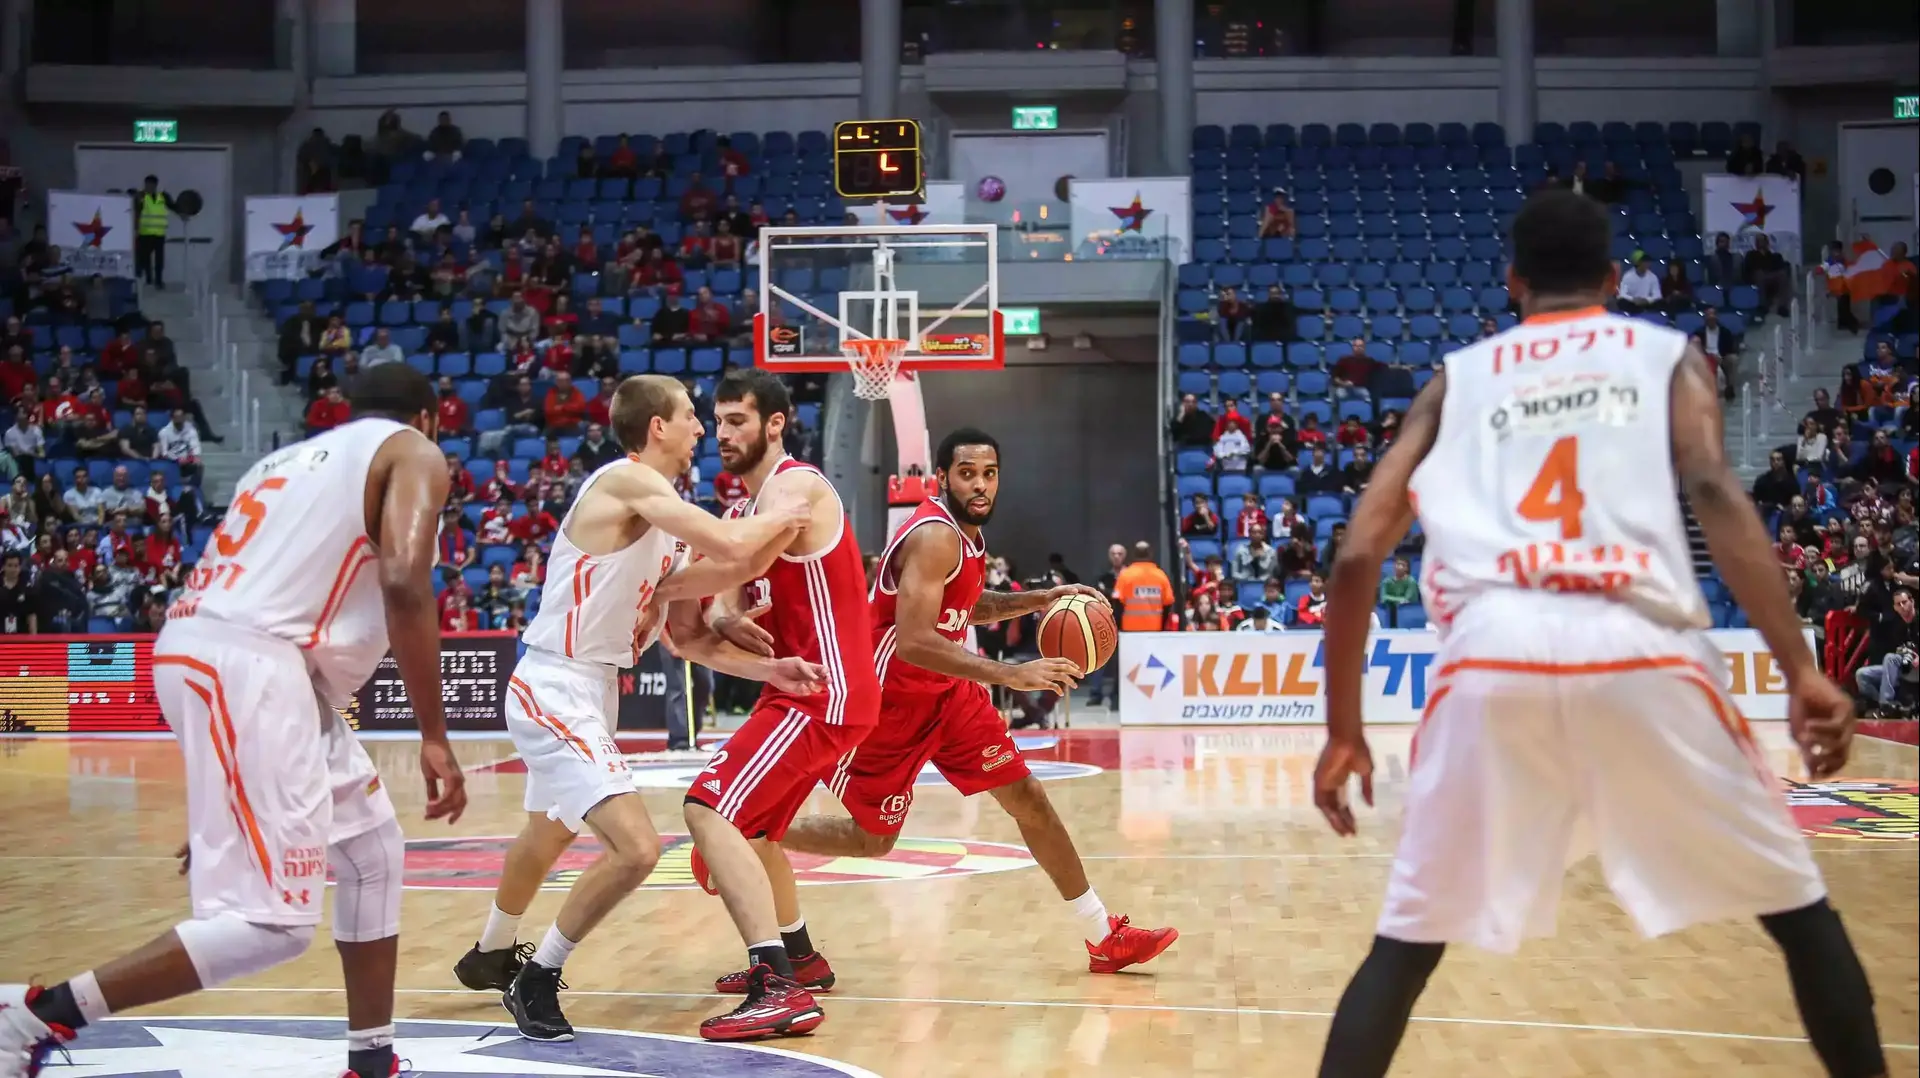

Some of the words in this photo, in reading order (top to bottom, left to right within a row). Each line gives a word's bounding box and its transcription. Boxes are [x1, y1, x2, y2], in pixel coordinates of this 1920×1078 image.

[1492, 327, 1635, 374] וילסון
[1517, 434, 1585, 540] 4
[1182, 653, 1320, 698] KLIL
[1182, 703, 1254, 720] מעוצבים
[1258, 701, 1315, 719] חלונות
